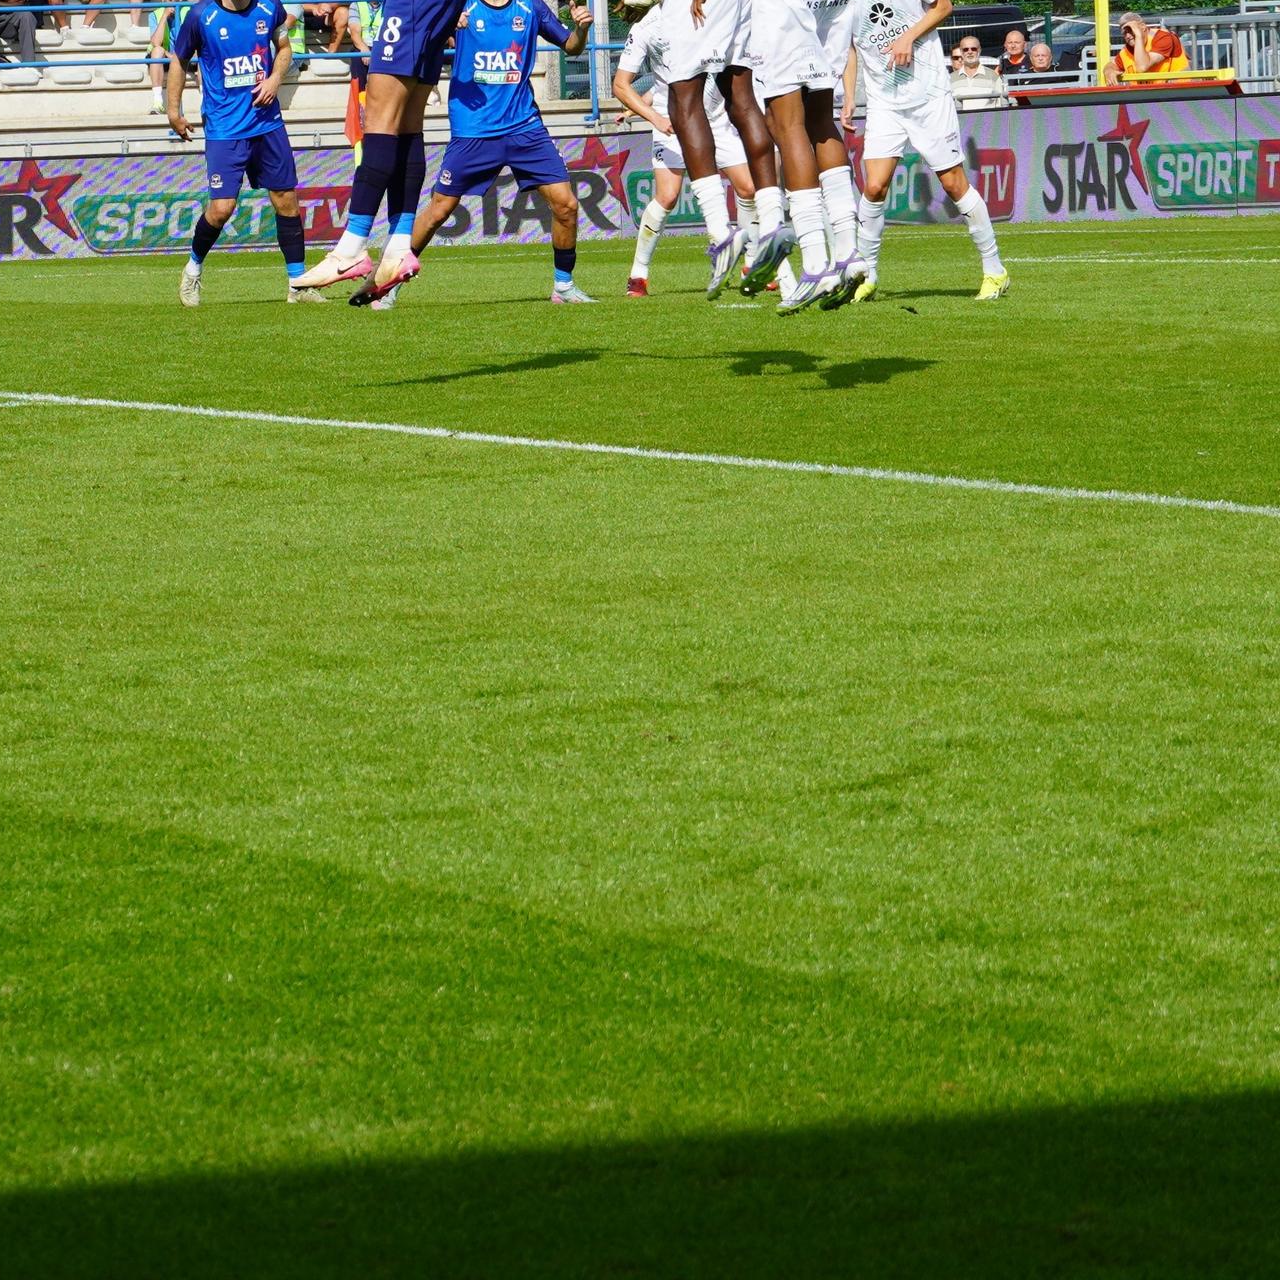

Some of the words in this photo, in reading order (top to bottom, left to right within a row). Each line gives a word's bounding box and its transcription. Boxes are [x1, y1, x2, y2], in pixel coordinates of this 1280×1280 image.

[869, 24, 910, 44] Golden
[223, 54, 264, 76] STAR
[474, 51, 519, 71] STAR
[226, 75, 256, 87] SPORT
[476, 72, 505, 83] SPORT
[507, 72, 520, 83] TV
[980, 163, 1011, 202] TV
[1042, 141, 1138, 214] STAR
[1156, 150, 1255, 198] SPORT
[301, 197, 352, 229] TV
